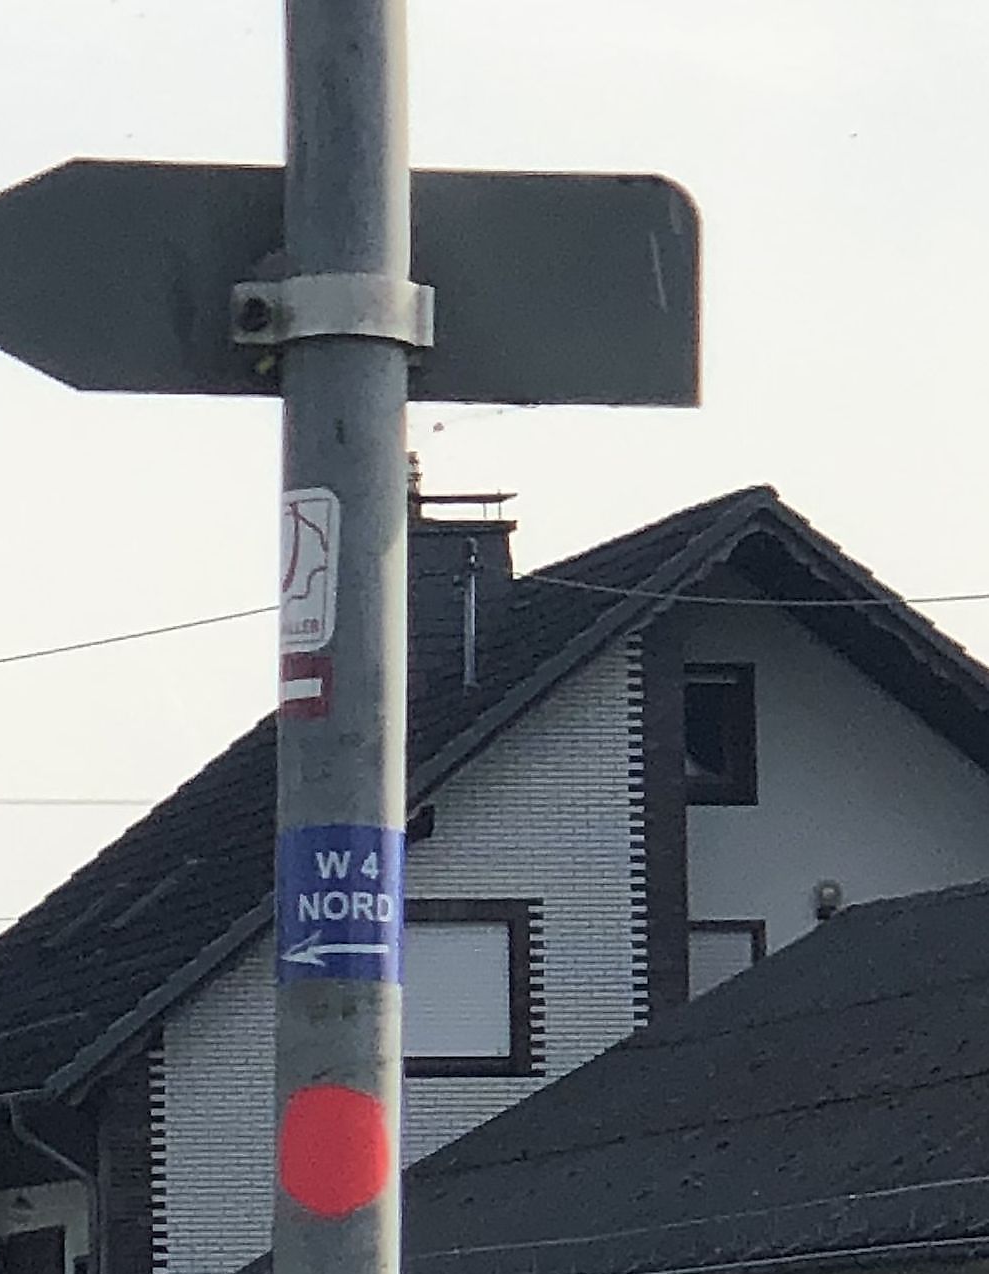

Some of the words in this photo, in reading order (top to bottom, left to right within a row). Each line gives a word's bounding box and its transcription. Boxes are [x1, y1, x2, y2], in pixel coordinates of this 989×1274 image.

[315, 850, 351, 880] W
[361, 851, 380, 880] 4
[298, 891, 395, 923] NORD
